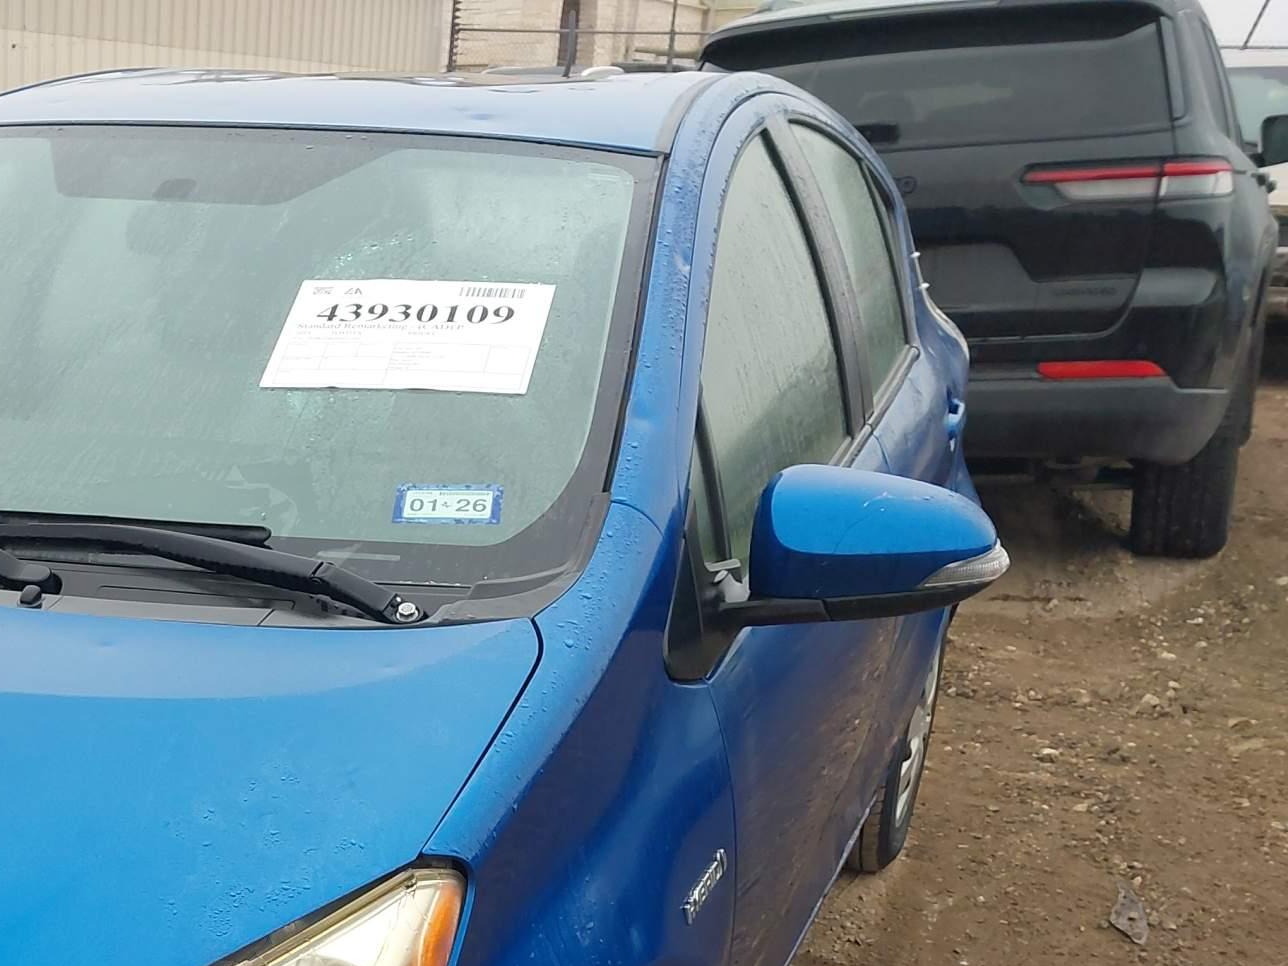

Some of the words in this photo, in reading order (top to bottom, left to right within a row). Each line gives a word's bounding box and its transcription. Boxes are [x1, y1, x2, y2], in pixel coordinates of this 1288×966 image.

[316, 302, 516, 325] 43930109
[409, 498, 438, 512] 01
[455, 498, 488, 513] 26
